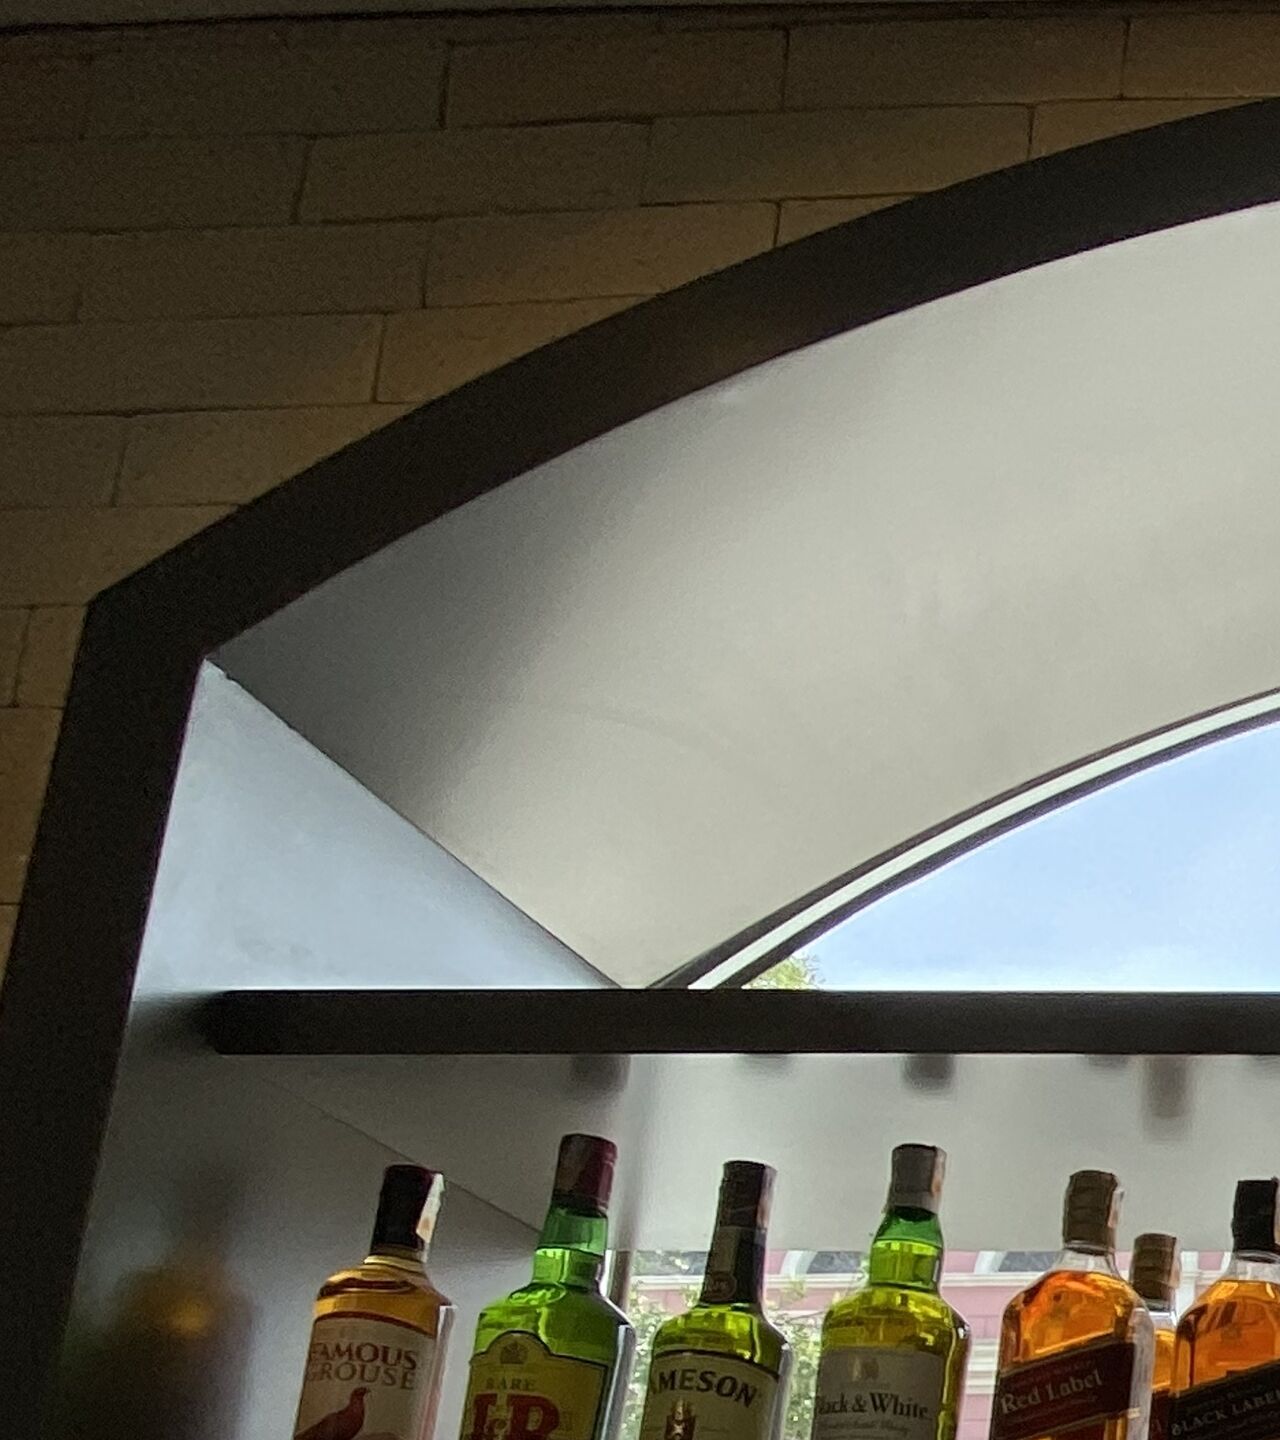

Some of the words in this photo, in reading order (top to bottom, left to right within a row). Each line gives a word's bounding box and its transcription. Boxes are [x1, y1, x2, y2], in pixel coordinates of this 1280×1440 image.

[311, 1342, 418, 1372] FAMOUS
[869, 1391, 929, 1420] White
[1000, 1385, 1041, 1415] Red
[1047, 1368, 1103, 1403] Label
